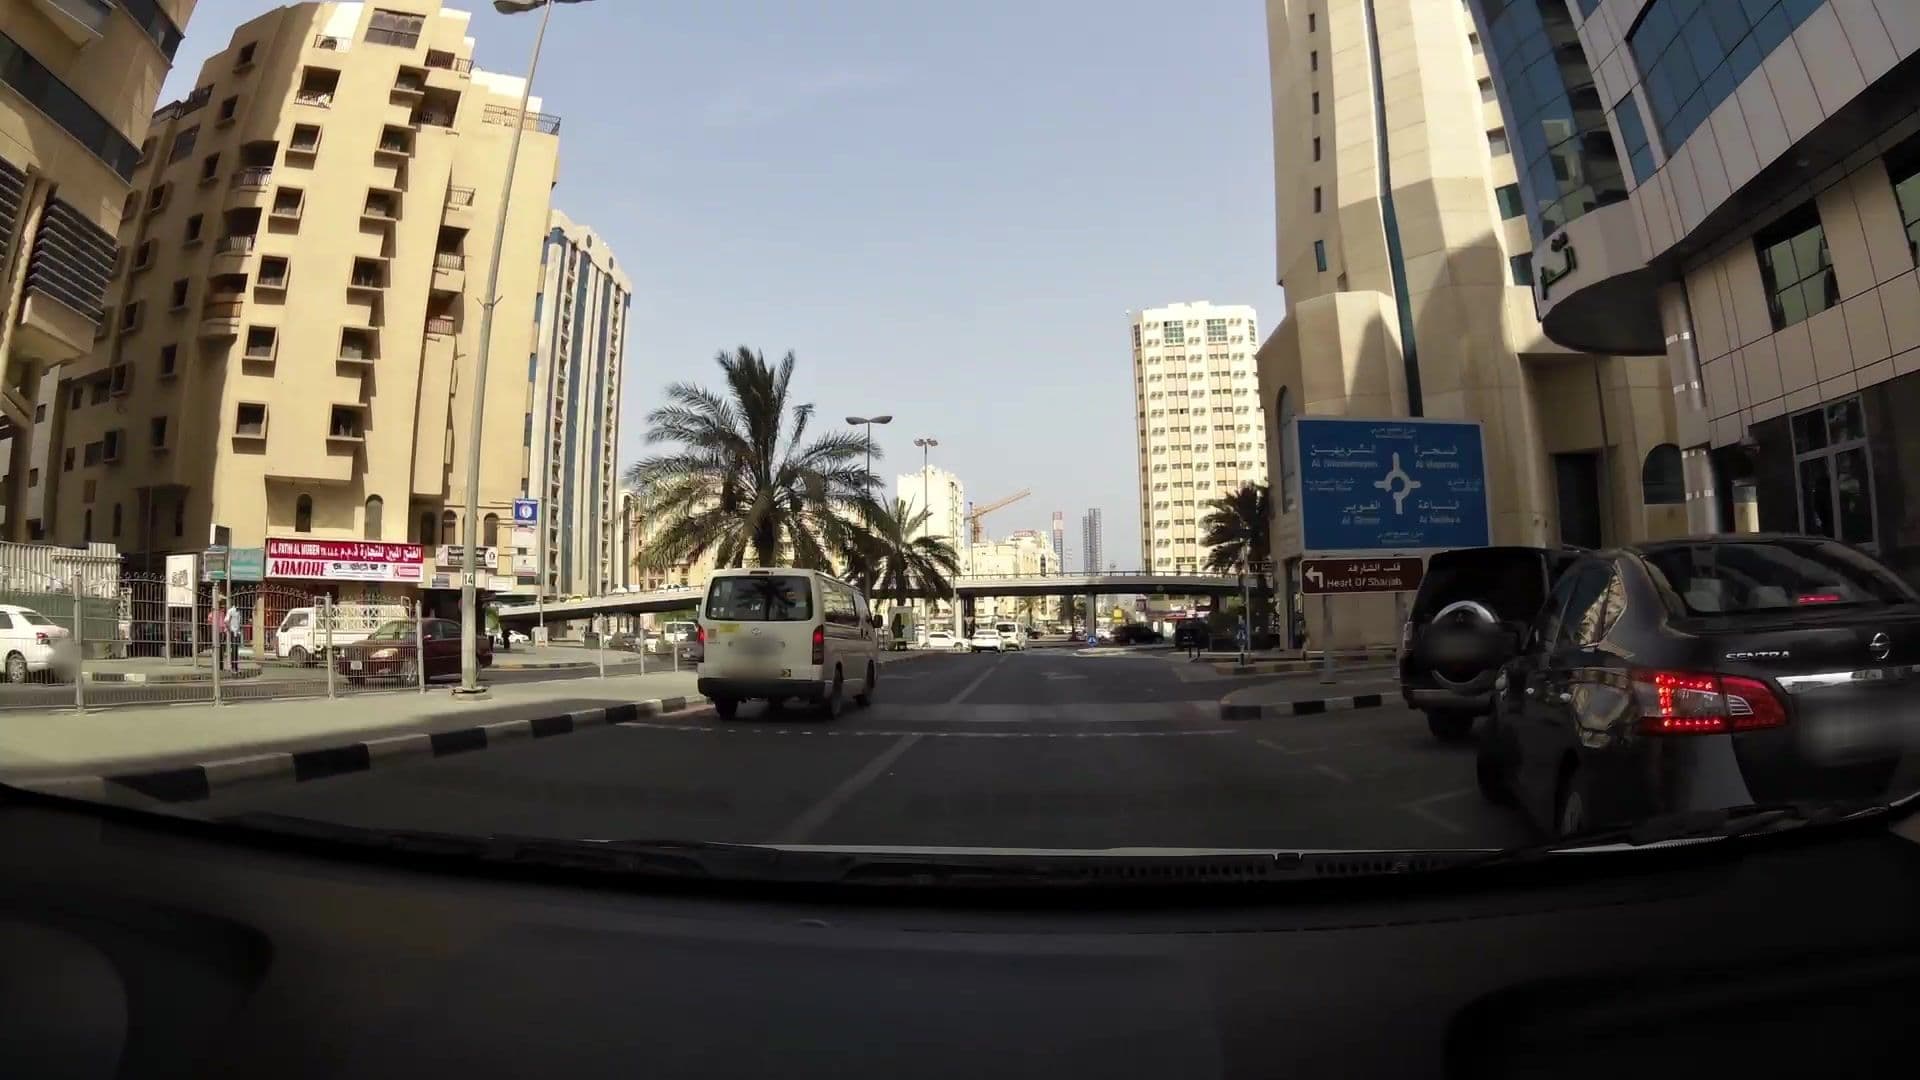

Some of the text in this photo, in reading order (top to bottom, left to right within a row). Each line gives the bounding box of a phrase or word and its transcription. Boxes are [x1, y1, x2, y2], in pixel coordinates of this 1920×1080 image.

[359, 543, 384, 560] للتجارة
[403, 545, 422, 562] الفتح
[270, 559, 328, 577] ADMORE
[1347, 562, 1401, 575] قلب الشارقة
[1327, 576, 1402, 588] Heart Of Sharjah
[1725, 651, 1790, 662] SENTRA
